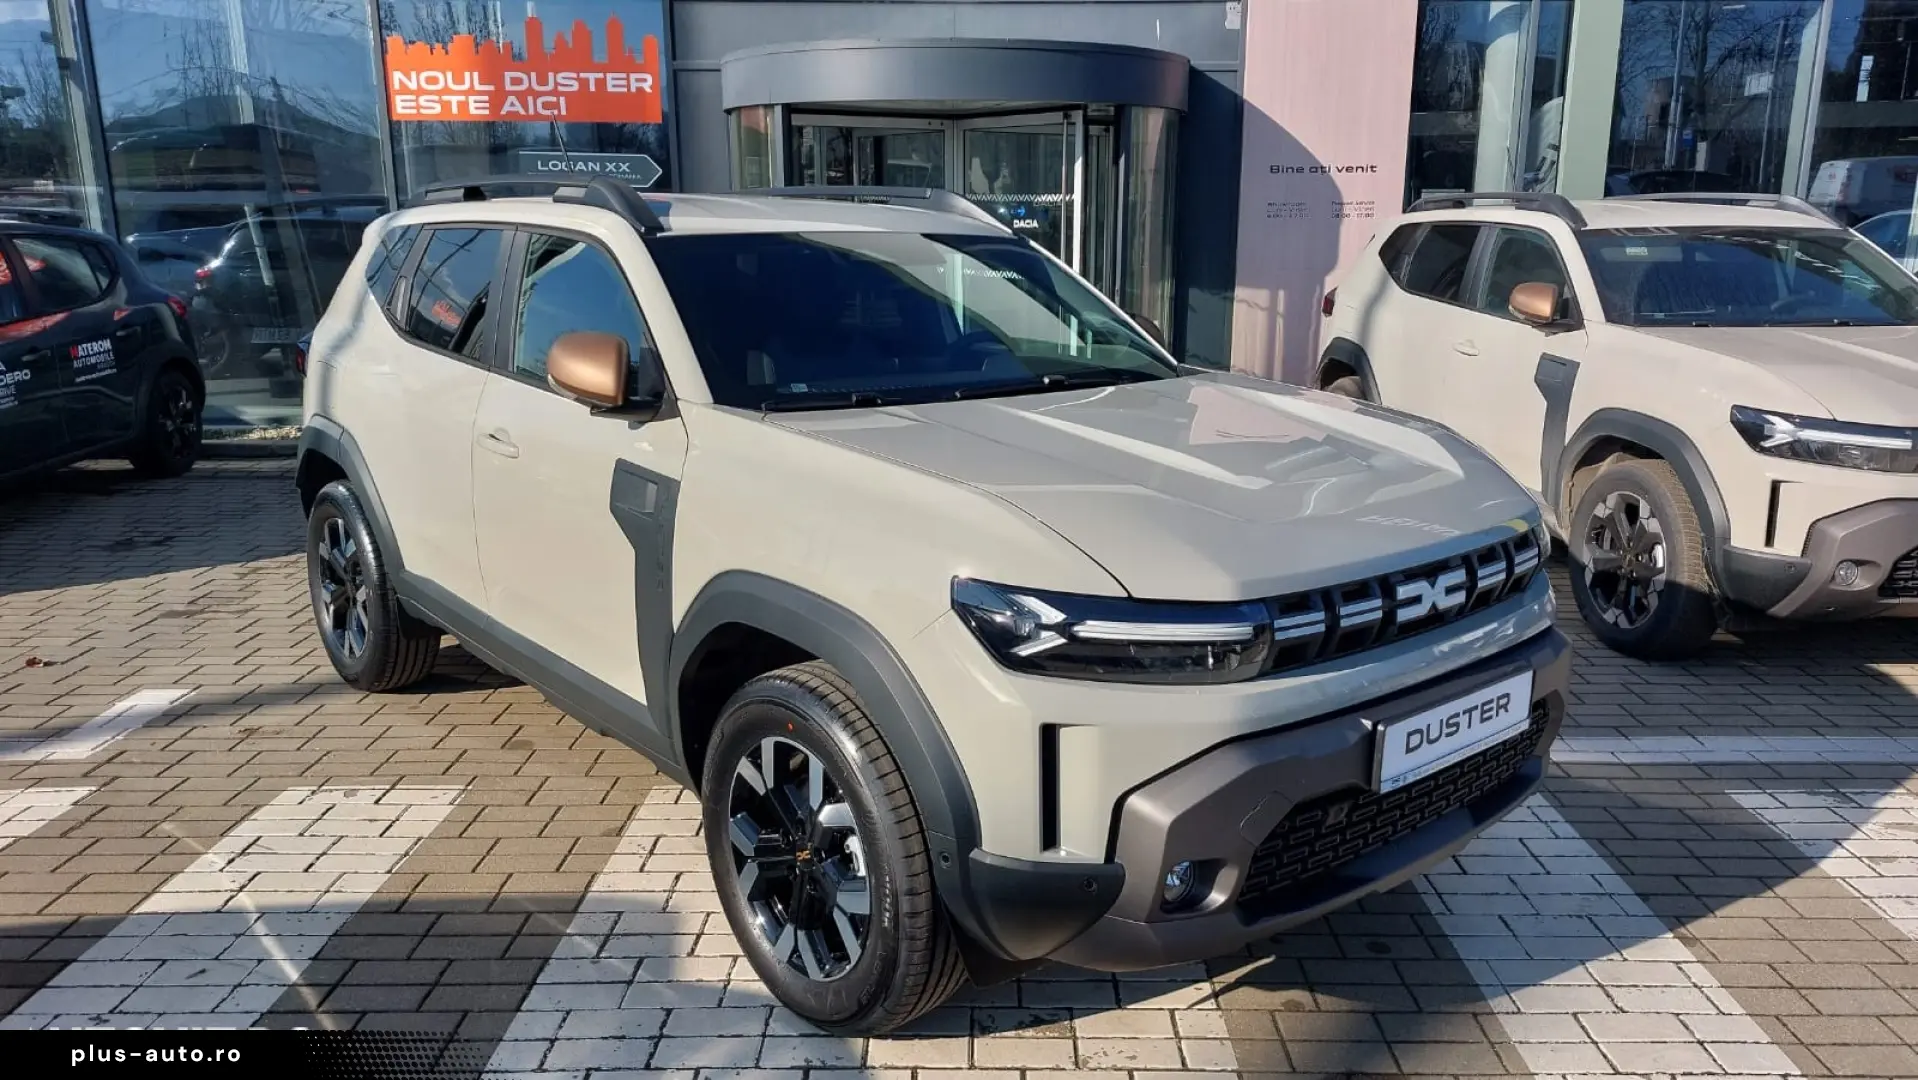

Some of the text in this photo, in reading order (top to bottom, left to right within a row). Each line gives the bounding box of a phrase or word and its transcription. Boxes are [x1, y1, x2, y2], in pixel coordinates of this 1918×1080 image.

[393, 70, 653, 93] NOUL DUSTER
[395, 95, 567, 116] ESTE AICI
[605, 162, 631, 173] XX
[1270, 164, 1305, 174] Bine
[1335, 164, 1378, 174] venit
[1013, 219, 1039, 228] DACIA
[69, 338, 112, 360] MATEROM
[73, 351, 115, 369] AUTOMOBILE
[1405, 692, 1511, 755] DUSTER
